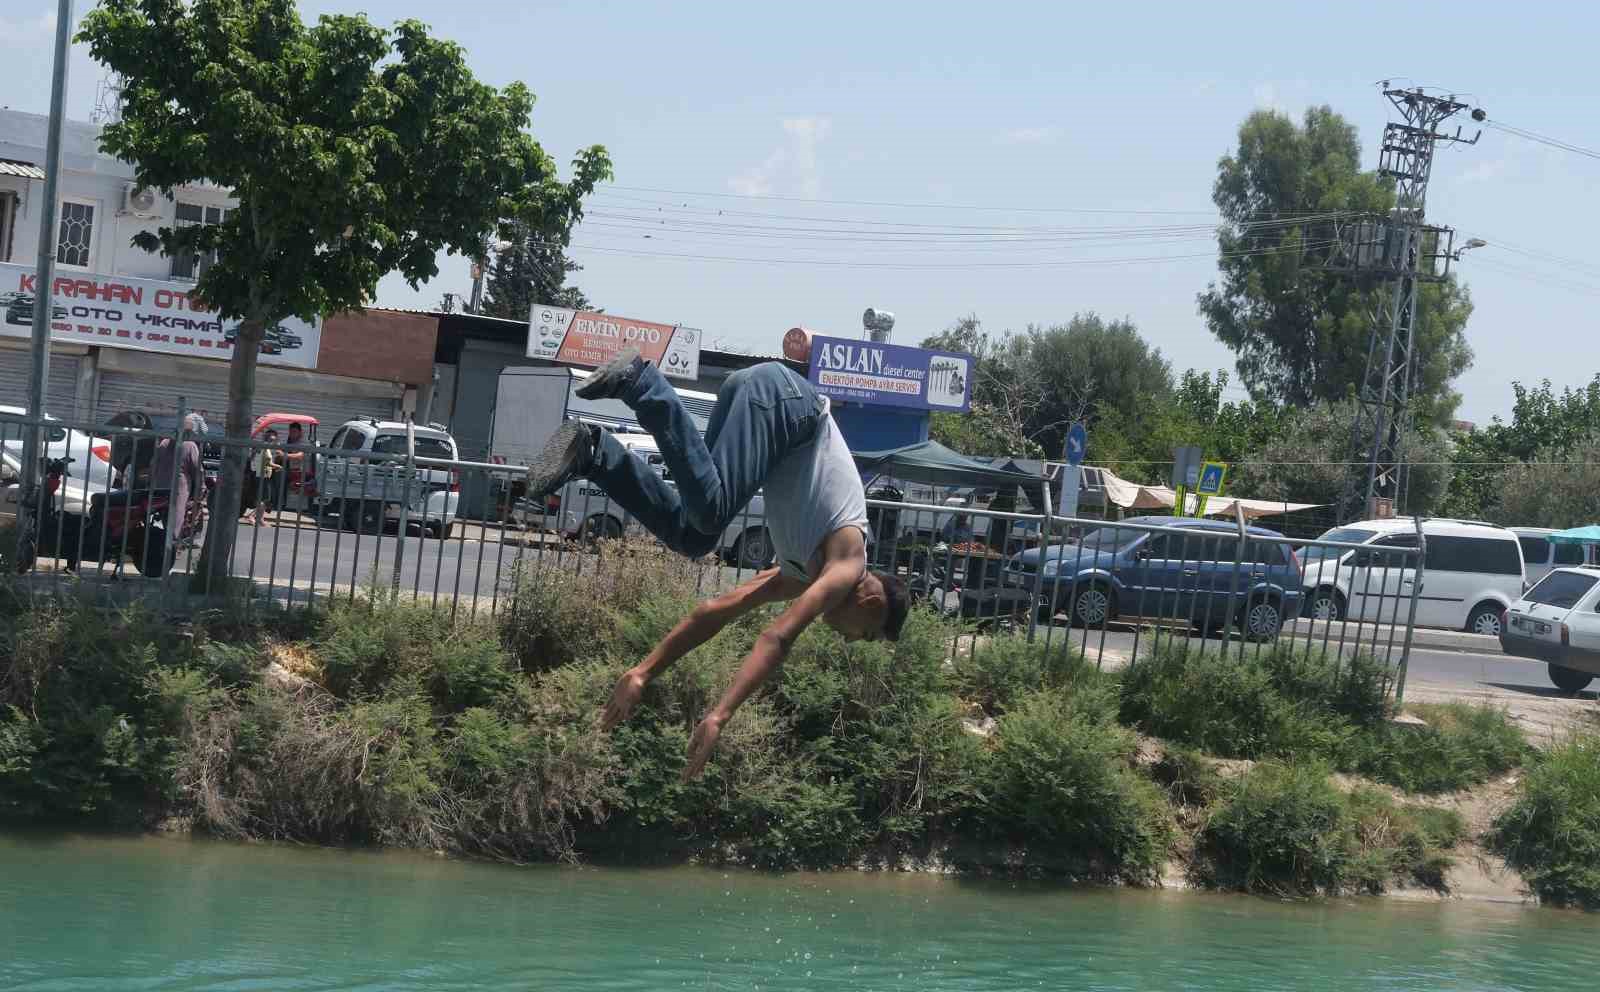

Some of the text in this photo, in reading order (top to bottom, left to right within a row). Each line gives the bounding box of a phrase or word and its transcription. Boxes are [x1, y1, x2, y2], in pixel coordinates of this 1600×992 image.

[19, 273, 143, 305] KRAHAN
[71, 306, 223, 334] OTO YIKAMA
[624, 326, 661, 344] OTO
[818, 343, 926, 379] ASLAN diesel center
